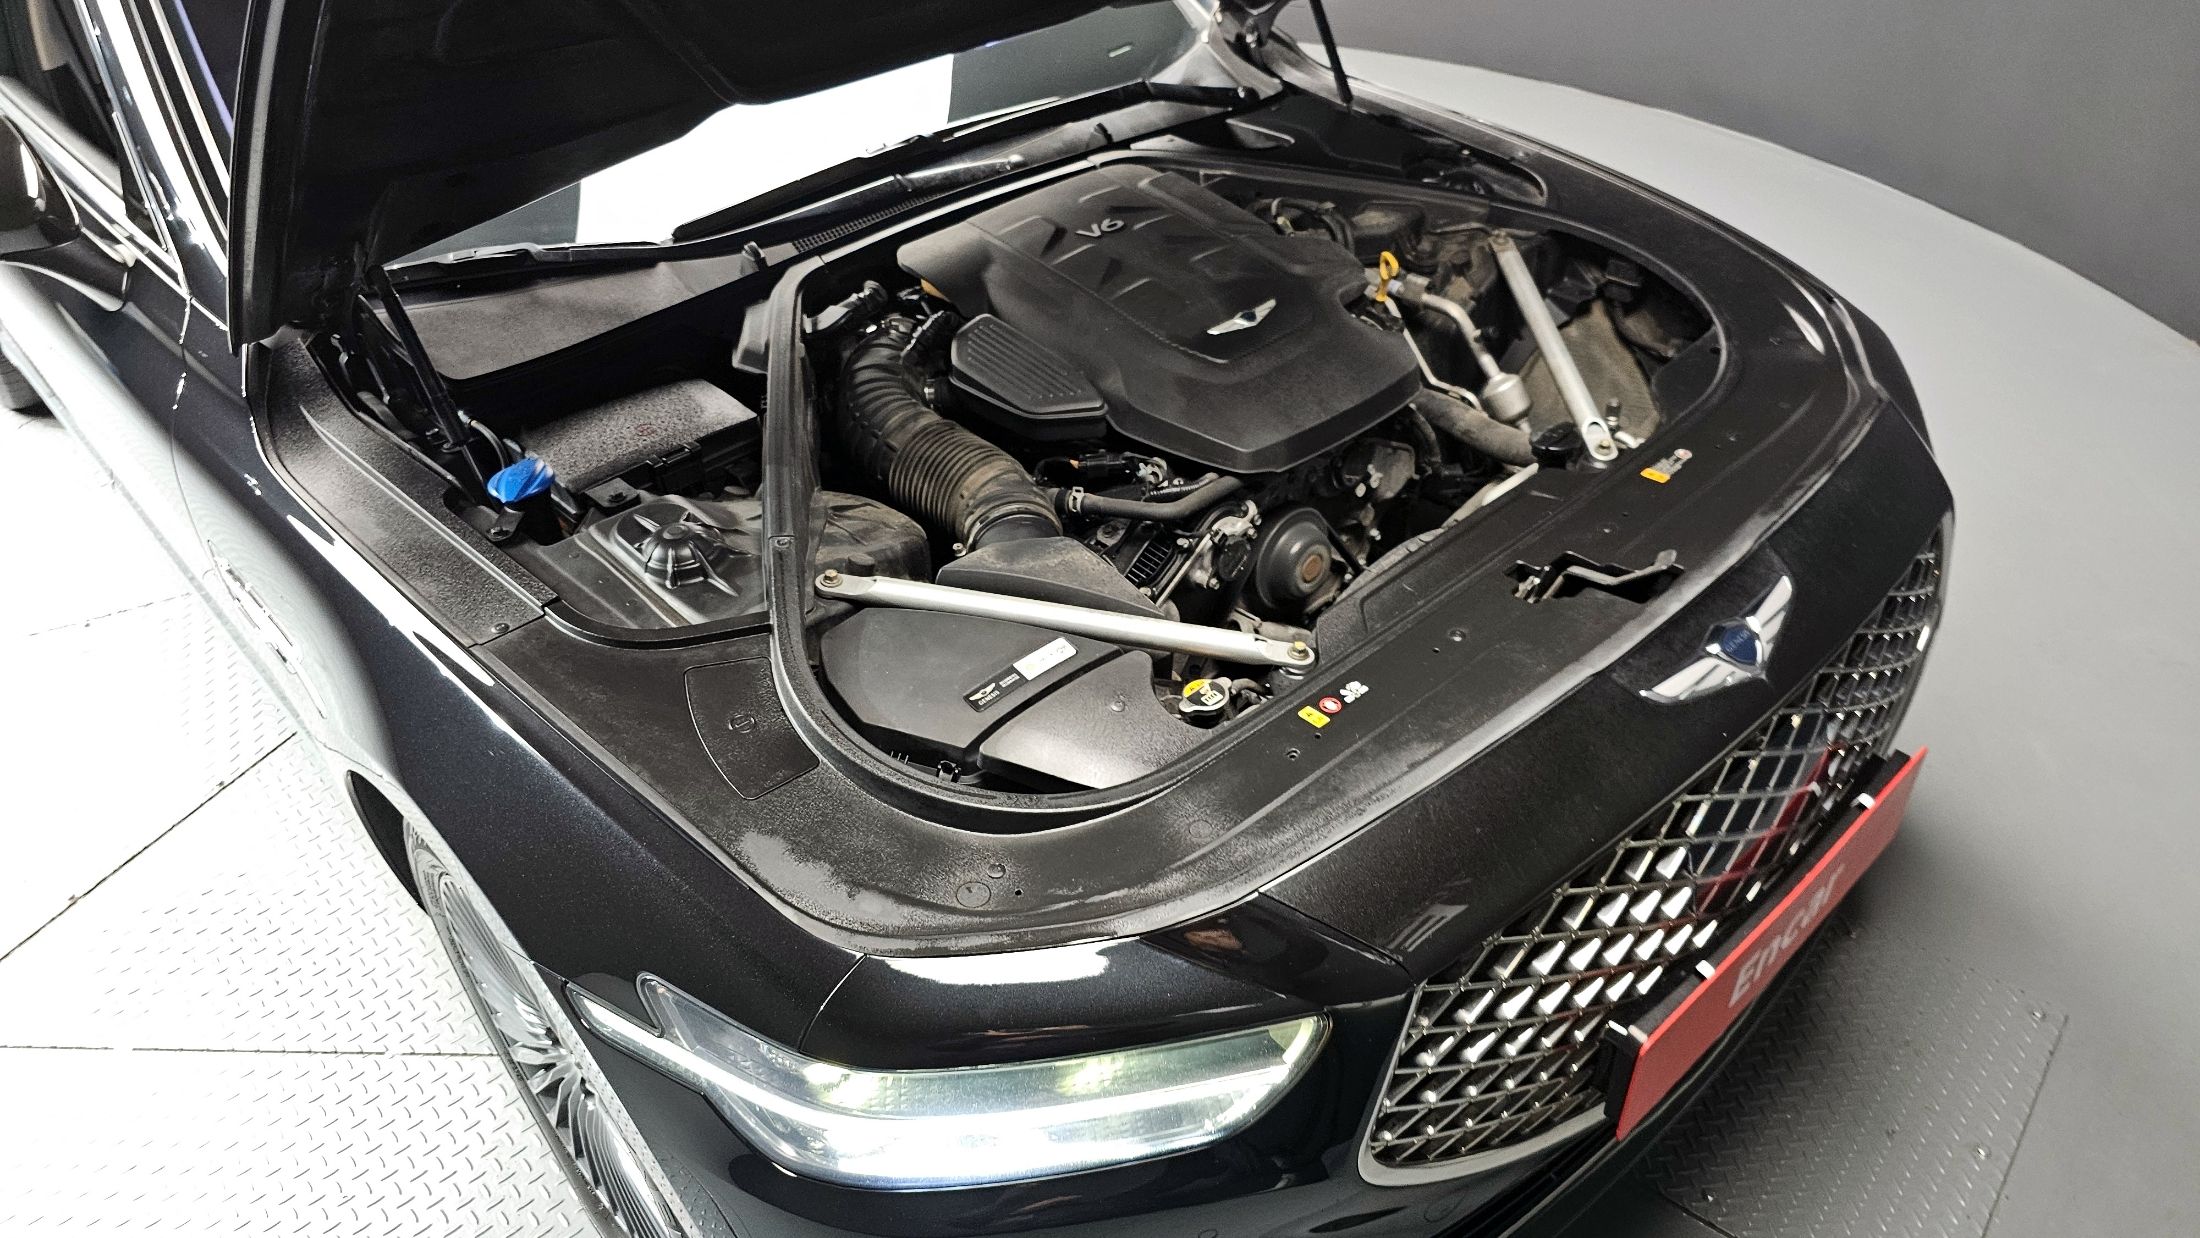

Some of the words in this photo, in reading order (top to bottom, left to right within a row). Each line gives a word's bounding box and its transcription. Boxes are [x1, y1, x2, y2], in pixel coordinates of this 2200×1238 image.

[1076, 218, 1124, 237] V6
[978, 690, 1000, 706] GENESIS
[1728, 863, 1846, 1008] Encar
